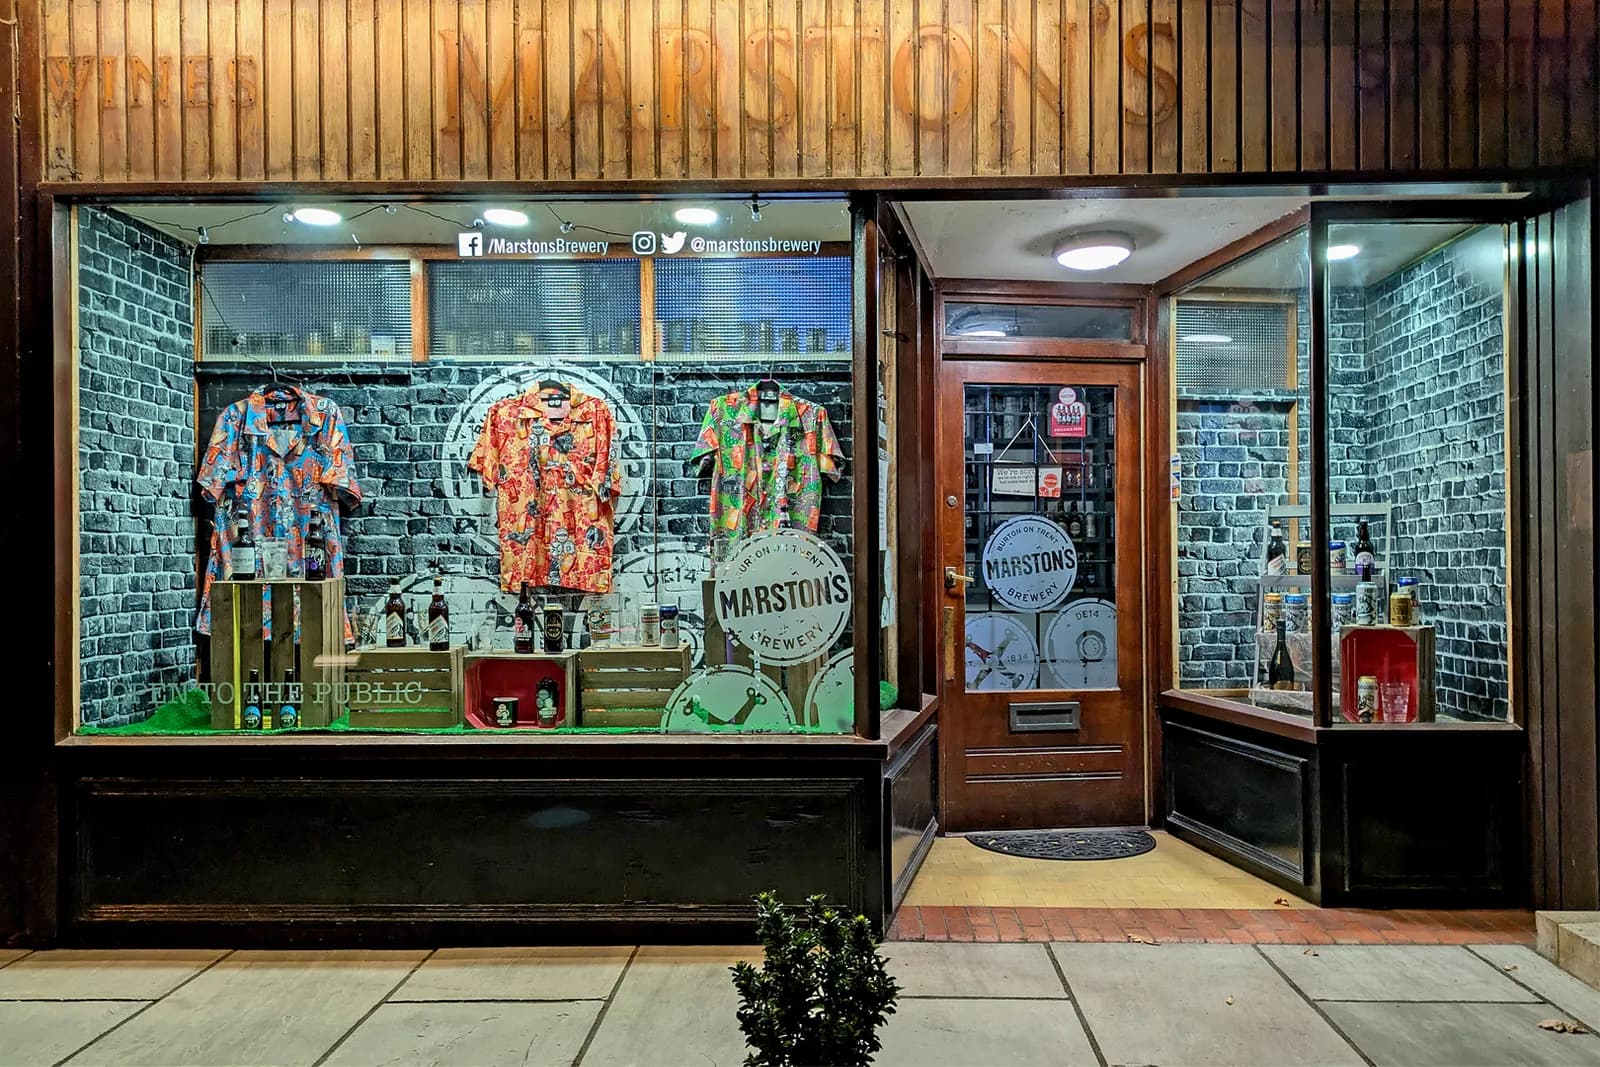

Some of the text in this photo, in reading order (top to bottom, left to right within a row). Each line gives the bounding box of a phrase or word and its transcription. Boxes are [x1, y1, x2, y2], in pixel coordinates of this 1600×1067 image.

[46, 56, 257, 109] WINES
[488, 238, 609, 256] /MarstonsBrewery
[691, 237, 821, 256] @marstonsbrewery
[997, 529, 1022, 552] BURTON
[1036, 527, 1059, 544] TRENT
[985, 546, 1075, 580] MARSTON'S
[719, 571, 849, 620] MARSTON'S
[1007, 582, 1059, 602] BREWERY
[1075, 609, 1100, 621] DE14
[750, 623, 824, 650] BREWERY
[199, 682, 235, 704] TO
[243, 682, 304, 704] THE
[312, 681, 423, 704] PUBLIC
